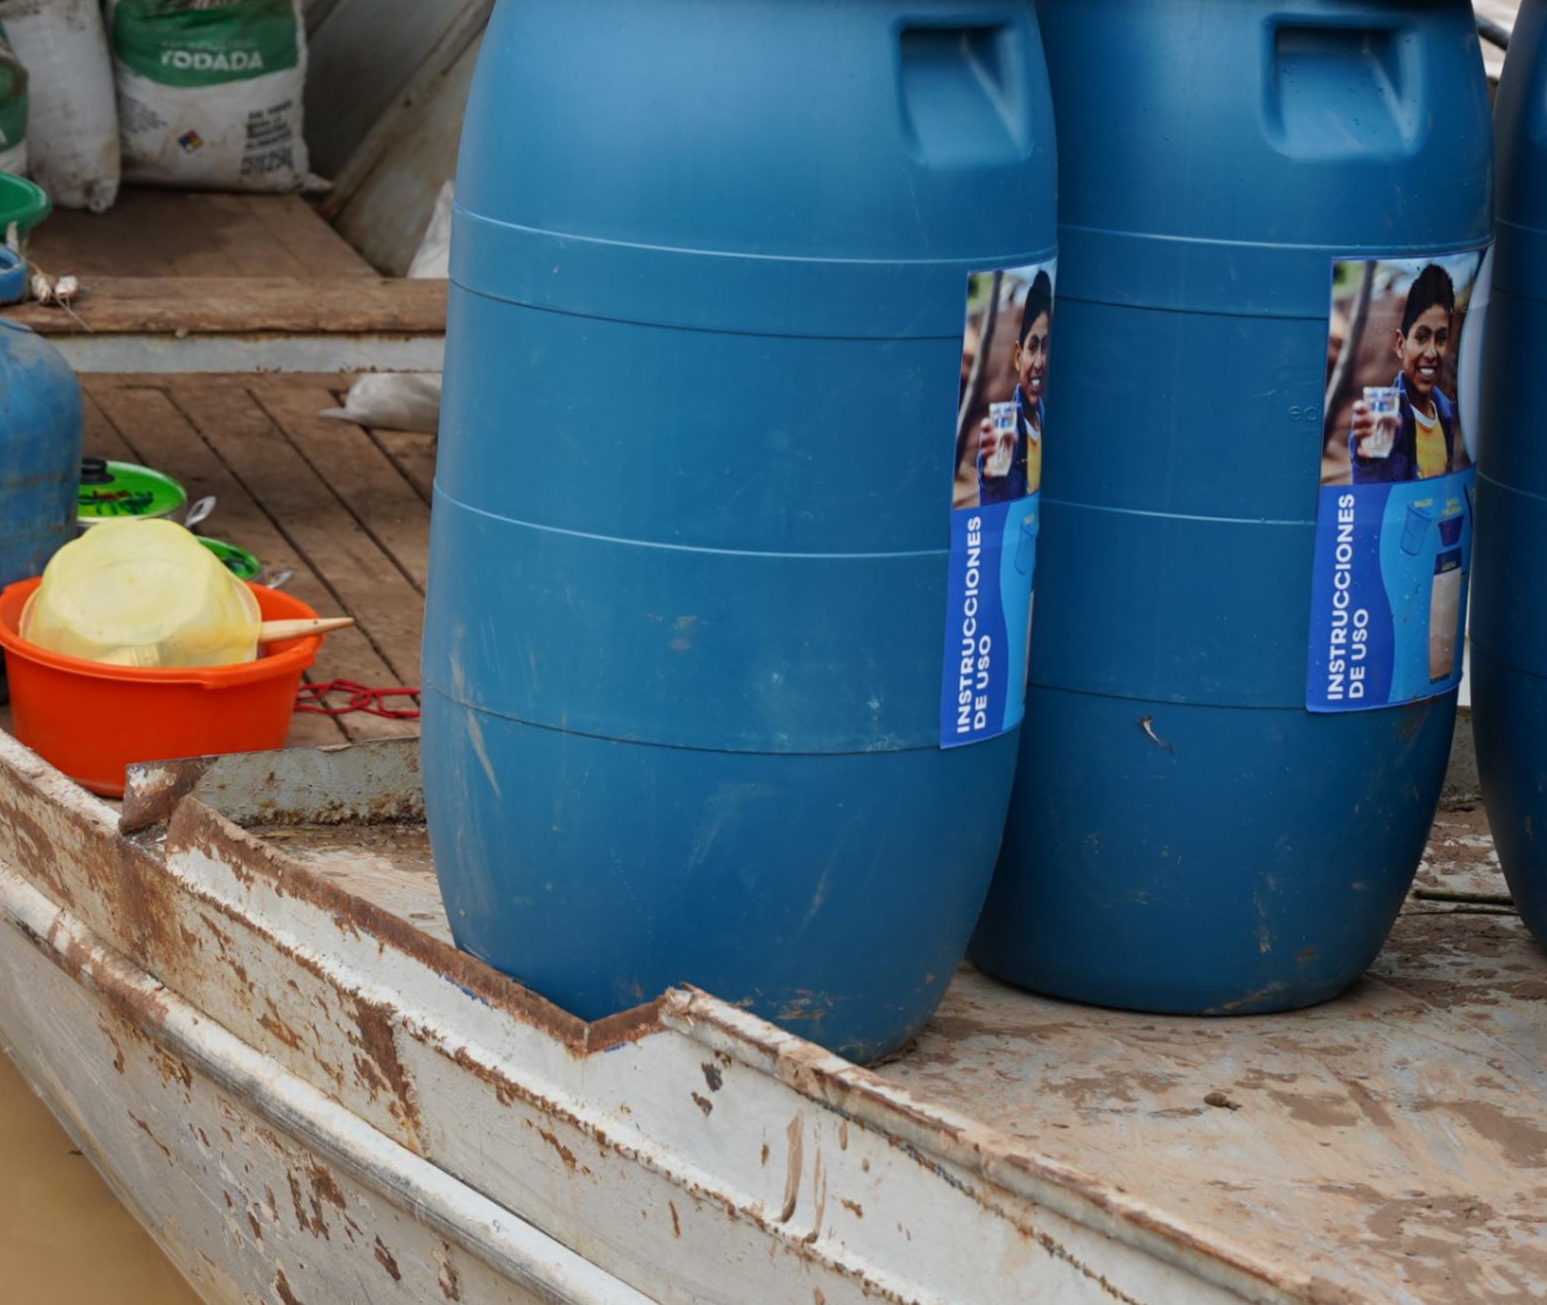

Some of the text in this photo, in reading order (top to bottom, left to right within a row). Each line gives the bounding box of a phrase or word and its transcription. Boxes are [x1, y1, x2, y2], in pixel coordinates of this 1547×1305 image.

[956, 516, 982, 734] INSTRUCCIONES
[1326, 493, 1355, 700] INSTRUCCIONES
[1348, 608, 1369, 699] DE USO
[973, 634, 992, 730] DE USO
